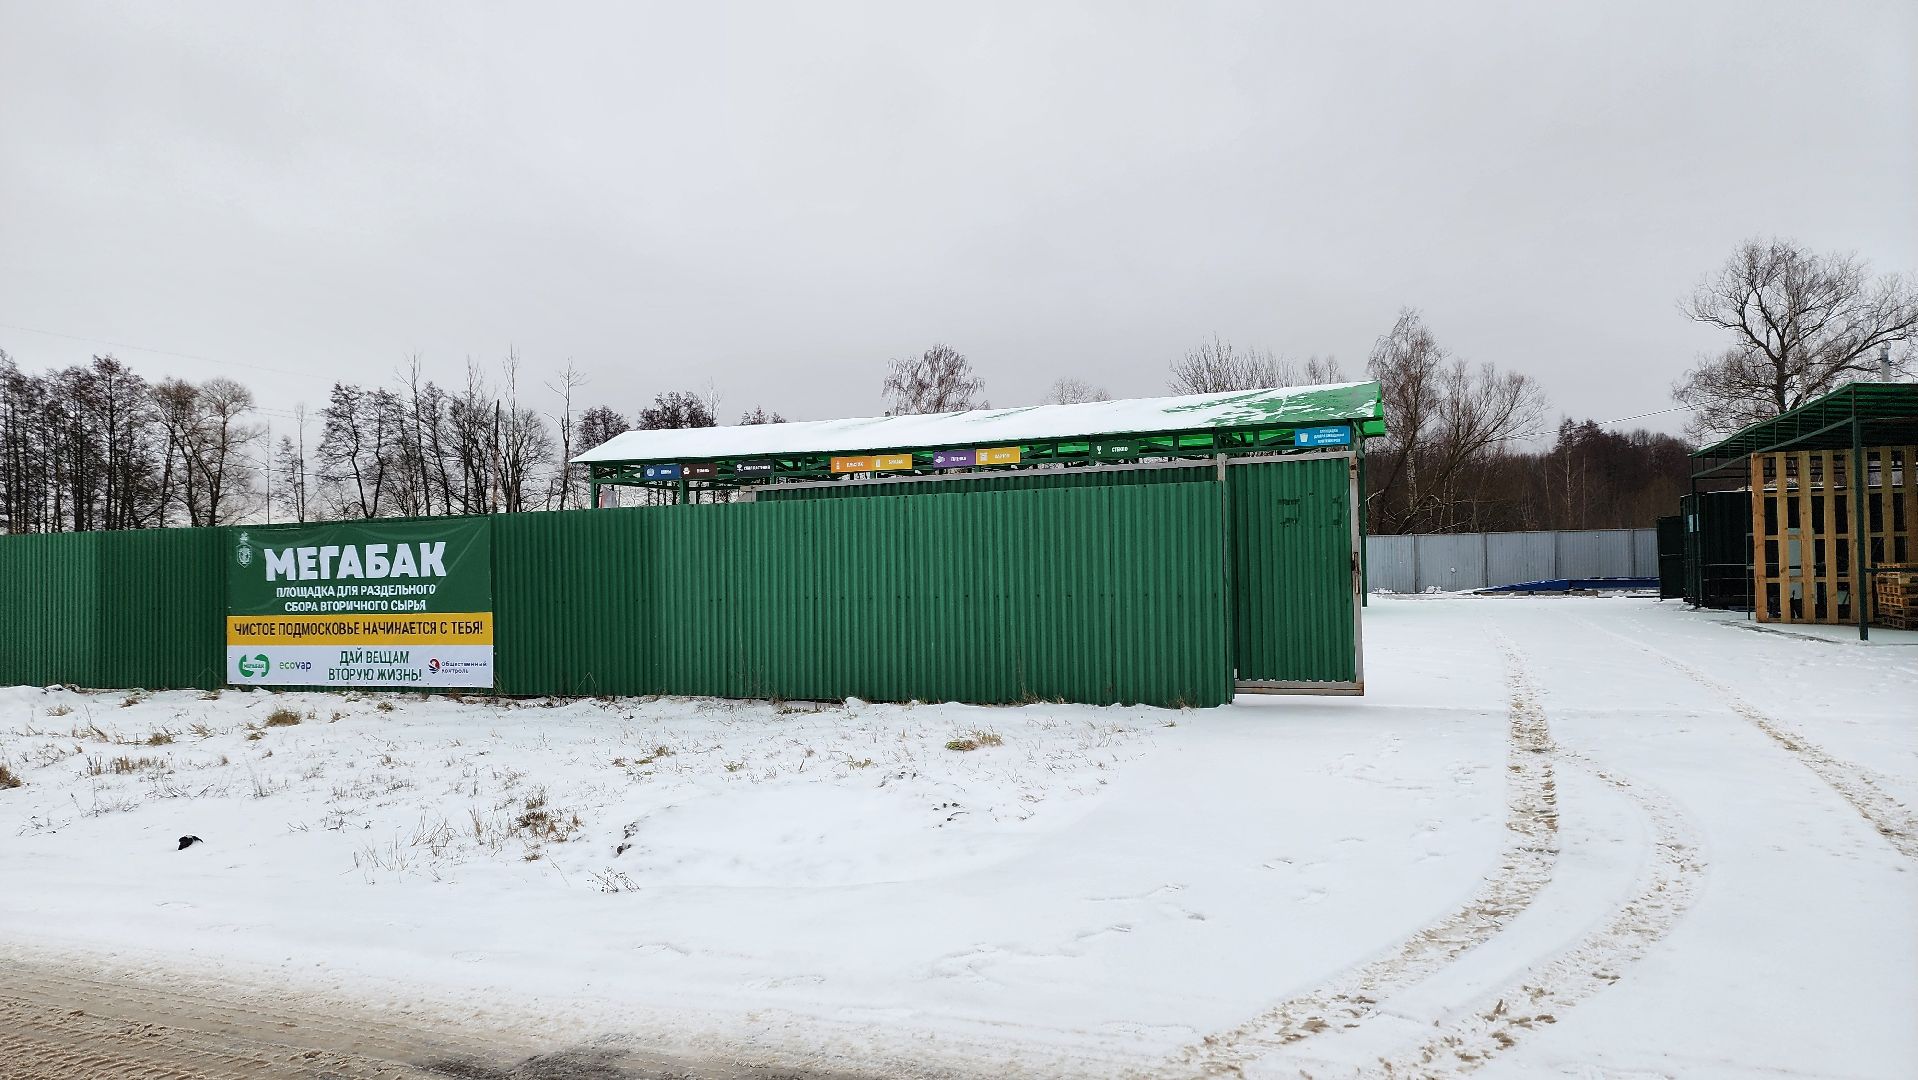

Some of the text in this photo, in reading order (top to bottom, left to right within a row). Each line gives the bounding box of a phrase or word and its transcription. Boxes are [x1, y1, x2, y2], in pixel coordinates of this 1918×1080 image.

[264, 541, 447, 581] МЕГАБАК
[276, 583, 436, 598] ПЛОЩАДКА ДЛЯ РАЗДЕЛЬНОГО
[284, 599, 427, 612] СБОРА ВТОРИЧНОГО СЫРЬЯ
[234, 621, 483, 638] ЧИСТОЕ ПОДМОСКОВЬЕ НАЧИНАЕТСЯ С ТЕБЯ!
[339, 647, 410, 667] ДАЙ ВЕЩАМ
[279, 661, 312, 672] ecovap
[328, 668, 422, 682] ВТОРУЮ ЖИЗНЬ!
